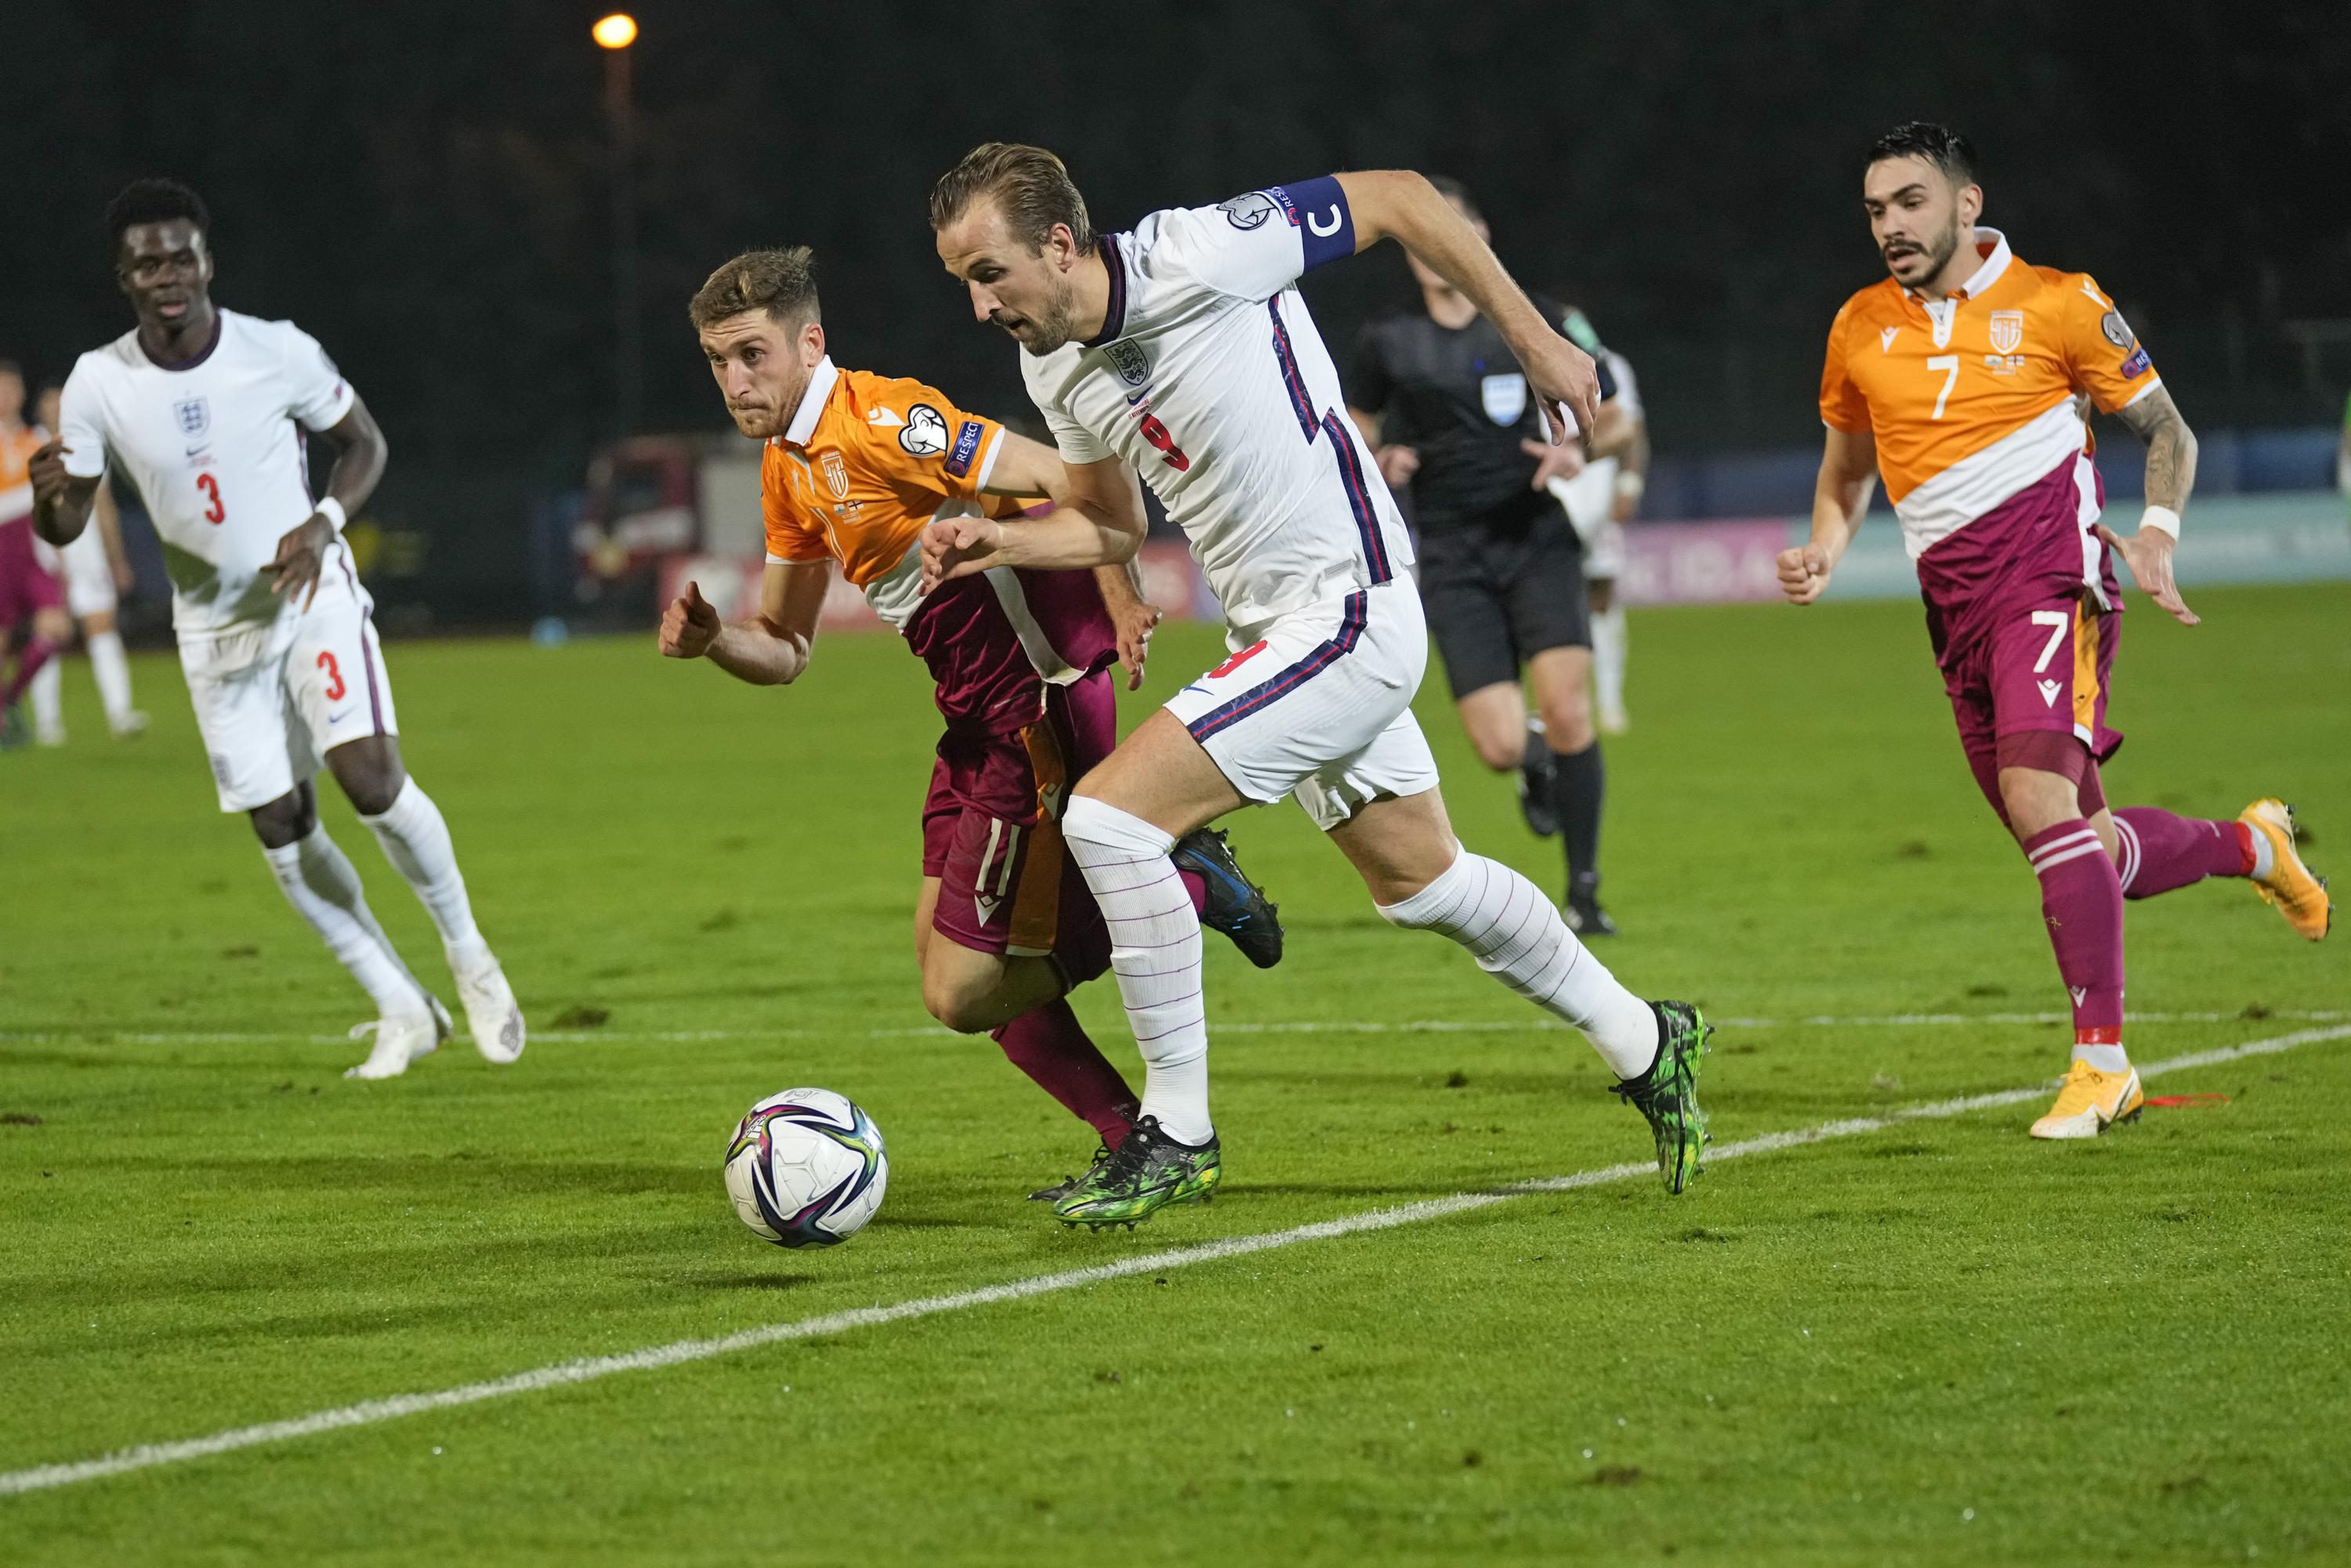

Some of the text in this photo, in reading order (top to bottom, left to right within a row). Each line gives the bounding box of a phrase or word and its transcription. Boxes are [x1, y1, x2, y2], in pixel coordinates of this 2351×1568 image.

[1307, 204, 1342, 237] C
[1927, 356, 1959, 419] 7
[1139, 413, 1190, 472] 9
[197, 473, 226, 524] 3
[1208, 639, 1268, 679] 9
[2031, 610, 2069, 673] 7
[317, 651, 346, 701] 3
[975, 817, 1021, 897] 11
